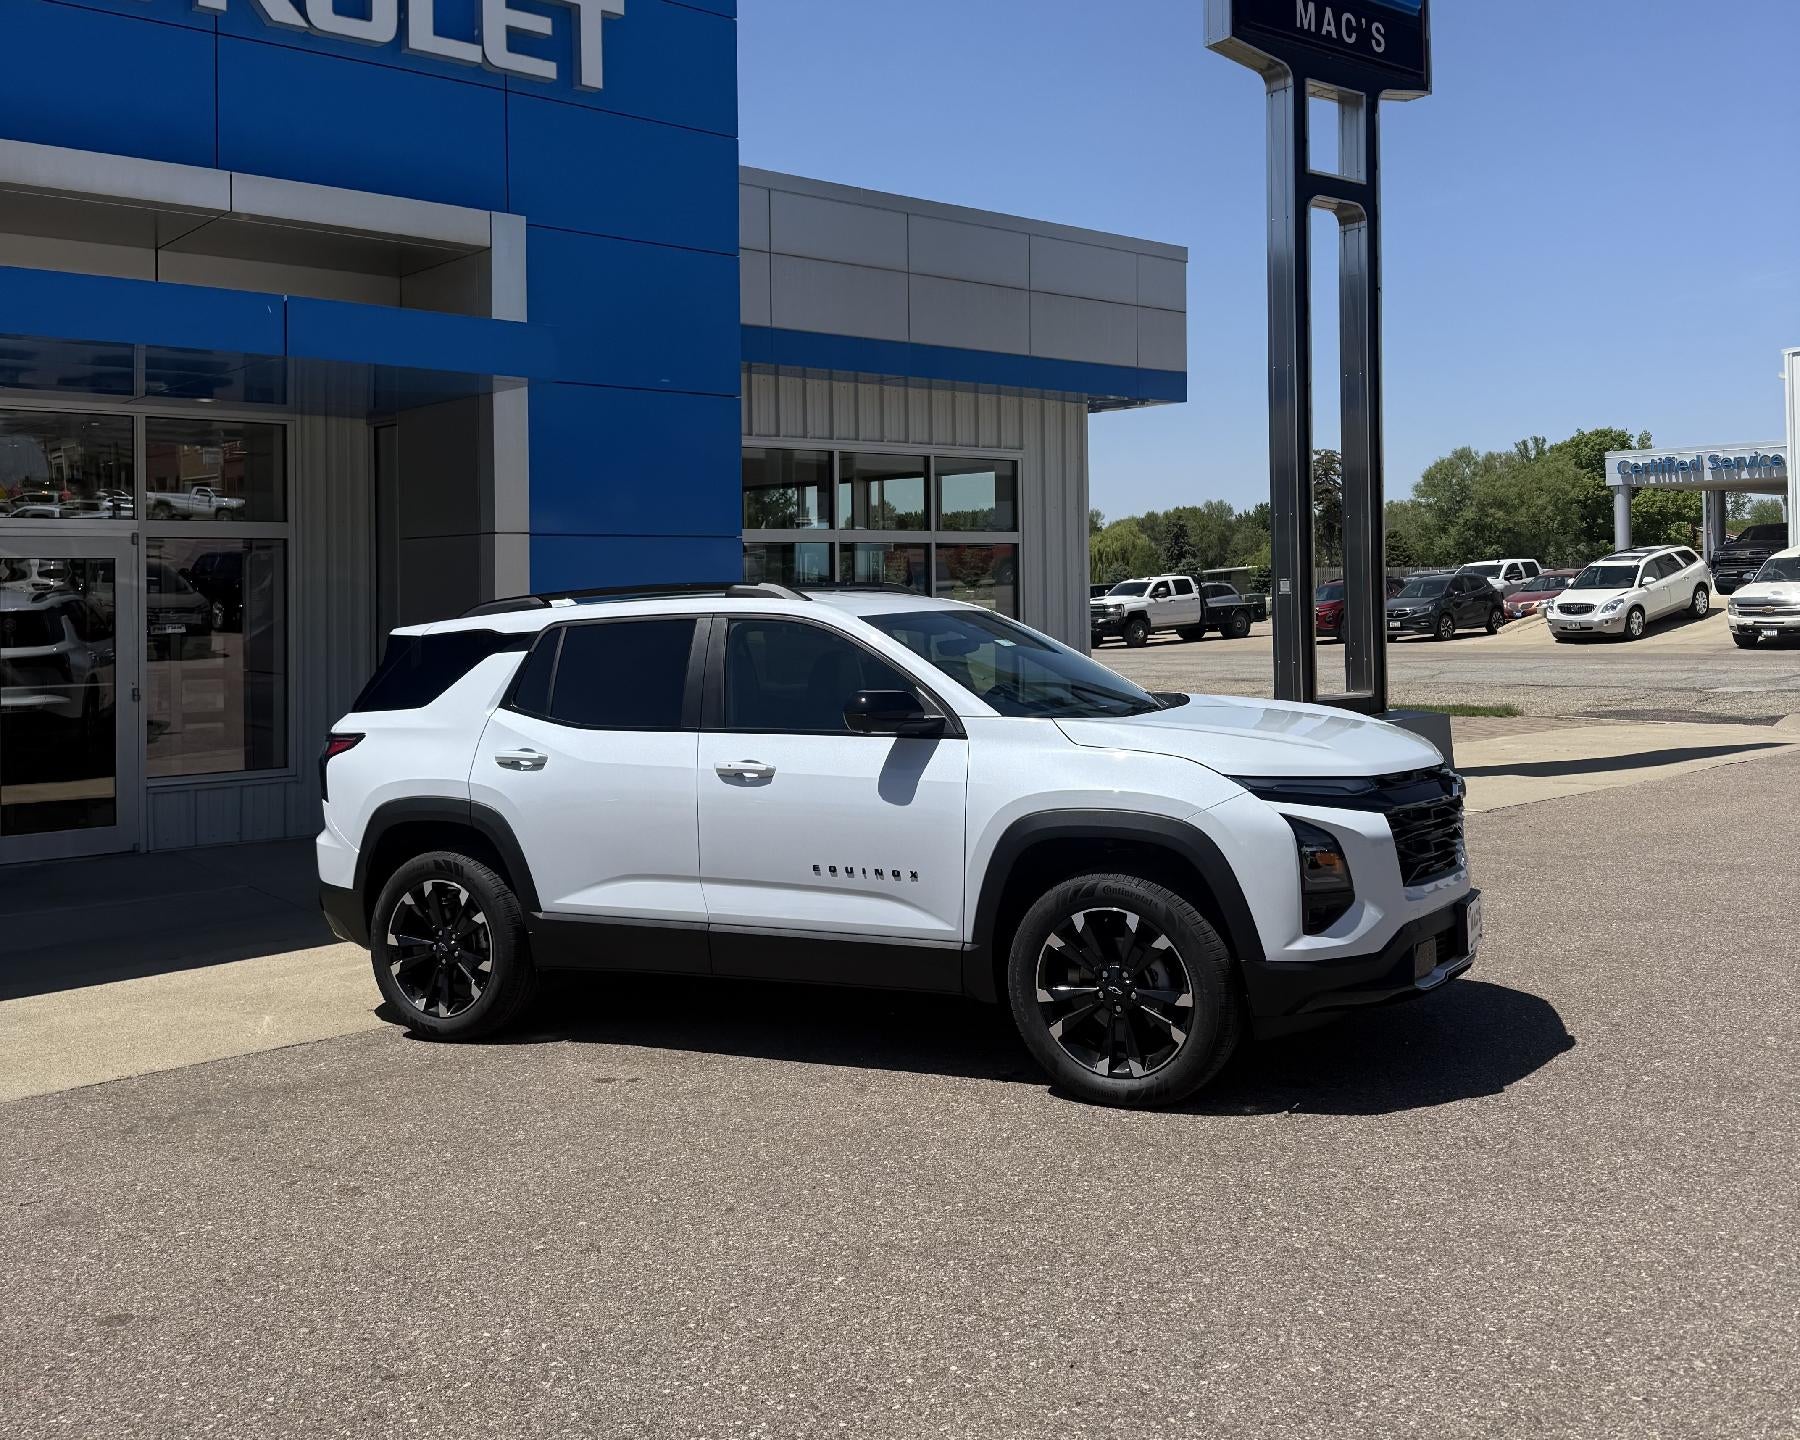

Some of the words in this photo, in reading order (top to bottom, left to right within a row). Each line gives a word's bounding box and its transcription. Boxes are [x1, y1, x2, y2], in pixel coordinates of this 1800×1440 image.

[192, 0, 625, 91] LET
[1296, 0, 1385, 53] MAC'S
[1617, 454, 1703, 476] Certified
[1708, 451, 1784, 472] Service
[812, 864, 919, 880] EQUINOX
